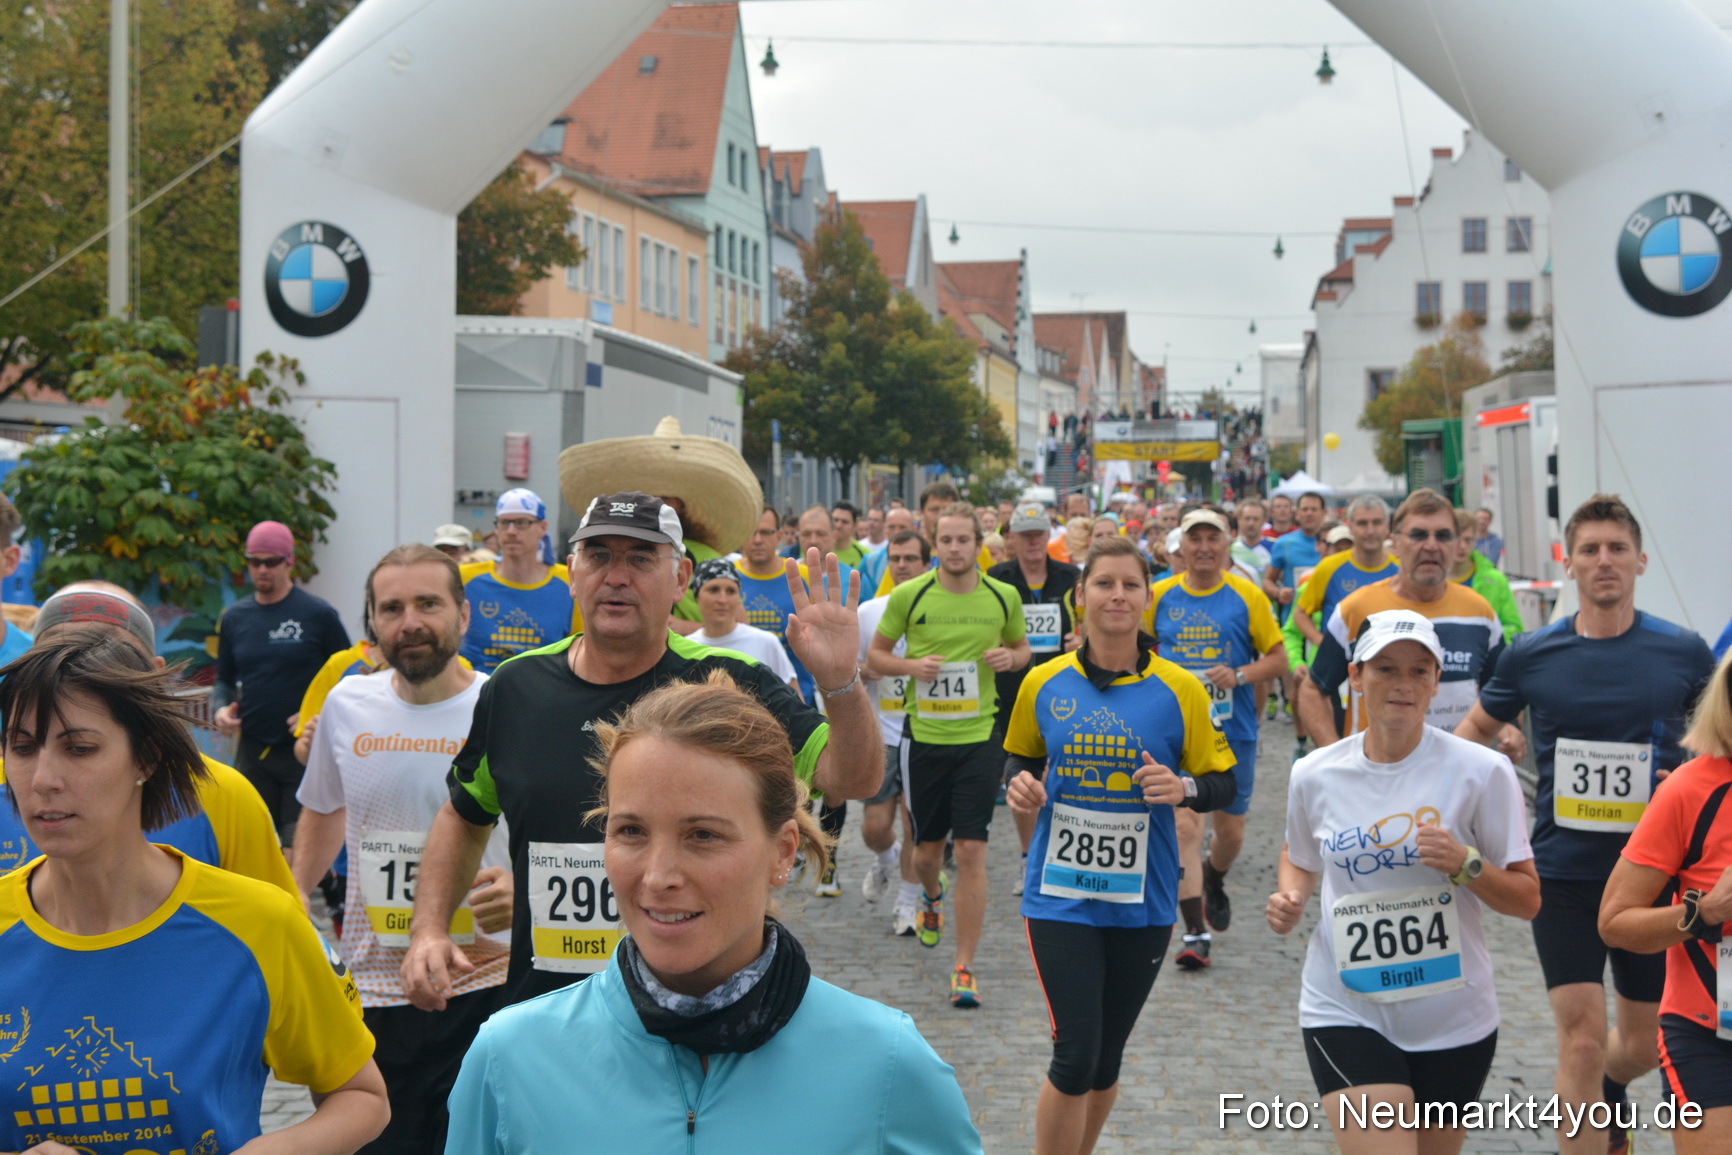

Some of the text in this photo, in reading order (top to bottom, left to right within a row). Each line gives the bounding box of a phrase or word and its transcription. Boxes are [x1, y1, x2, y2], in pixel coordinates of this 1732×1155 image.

[1626, 193, 1732, 239] BMW
[271, 223, 361, 264] BMW
[1135, 446, 1176, 457] START
[894, 679, 908, 696] 3
[928, 677, 966, 697] 214
[1556, 747, 1636, 761] PARTL Neumarkt
[1572, 762, 1632, 797] 313
[1053, 811, 1131, 832] PARTL Neumarkt
[1577, 803, 1623, 819] Florian
[361, 841, 396, 854] PARTL
[1056, 828, 1138, 869] 2859
[1322, 824, 1382, 856] NEW
[530, 855, 562, 869] PARTL
[1334, 846, 1424, 882] YORK
[1075, 873, 1109, 891] Katja
[547, 875, 621, 923] 296
[1334, 897, 1435, 918] PARTL Neumarkt
[562, 935, 607, 955] Horst
[1346, 911, 1450, 963] 2664
[1380, 966, 1425, 987] Birgit
[134, 1123, 174, 1141] 2014
